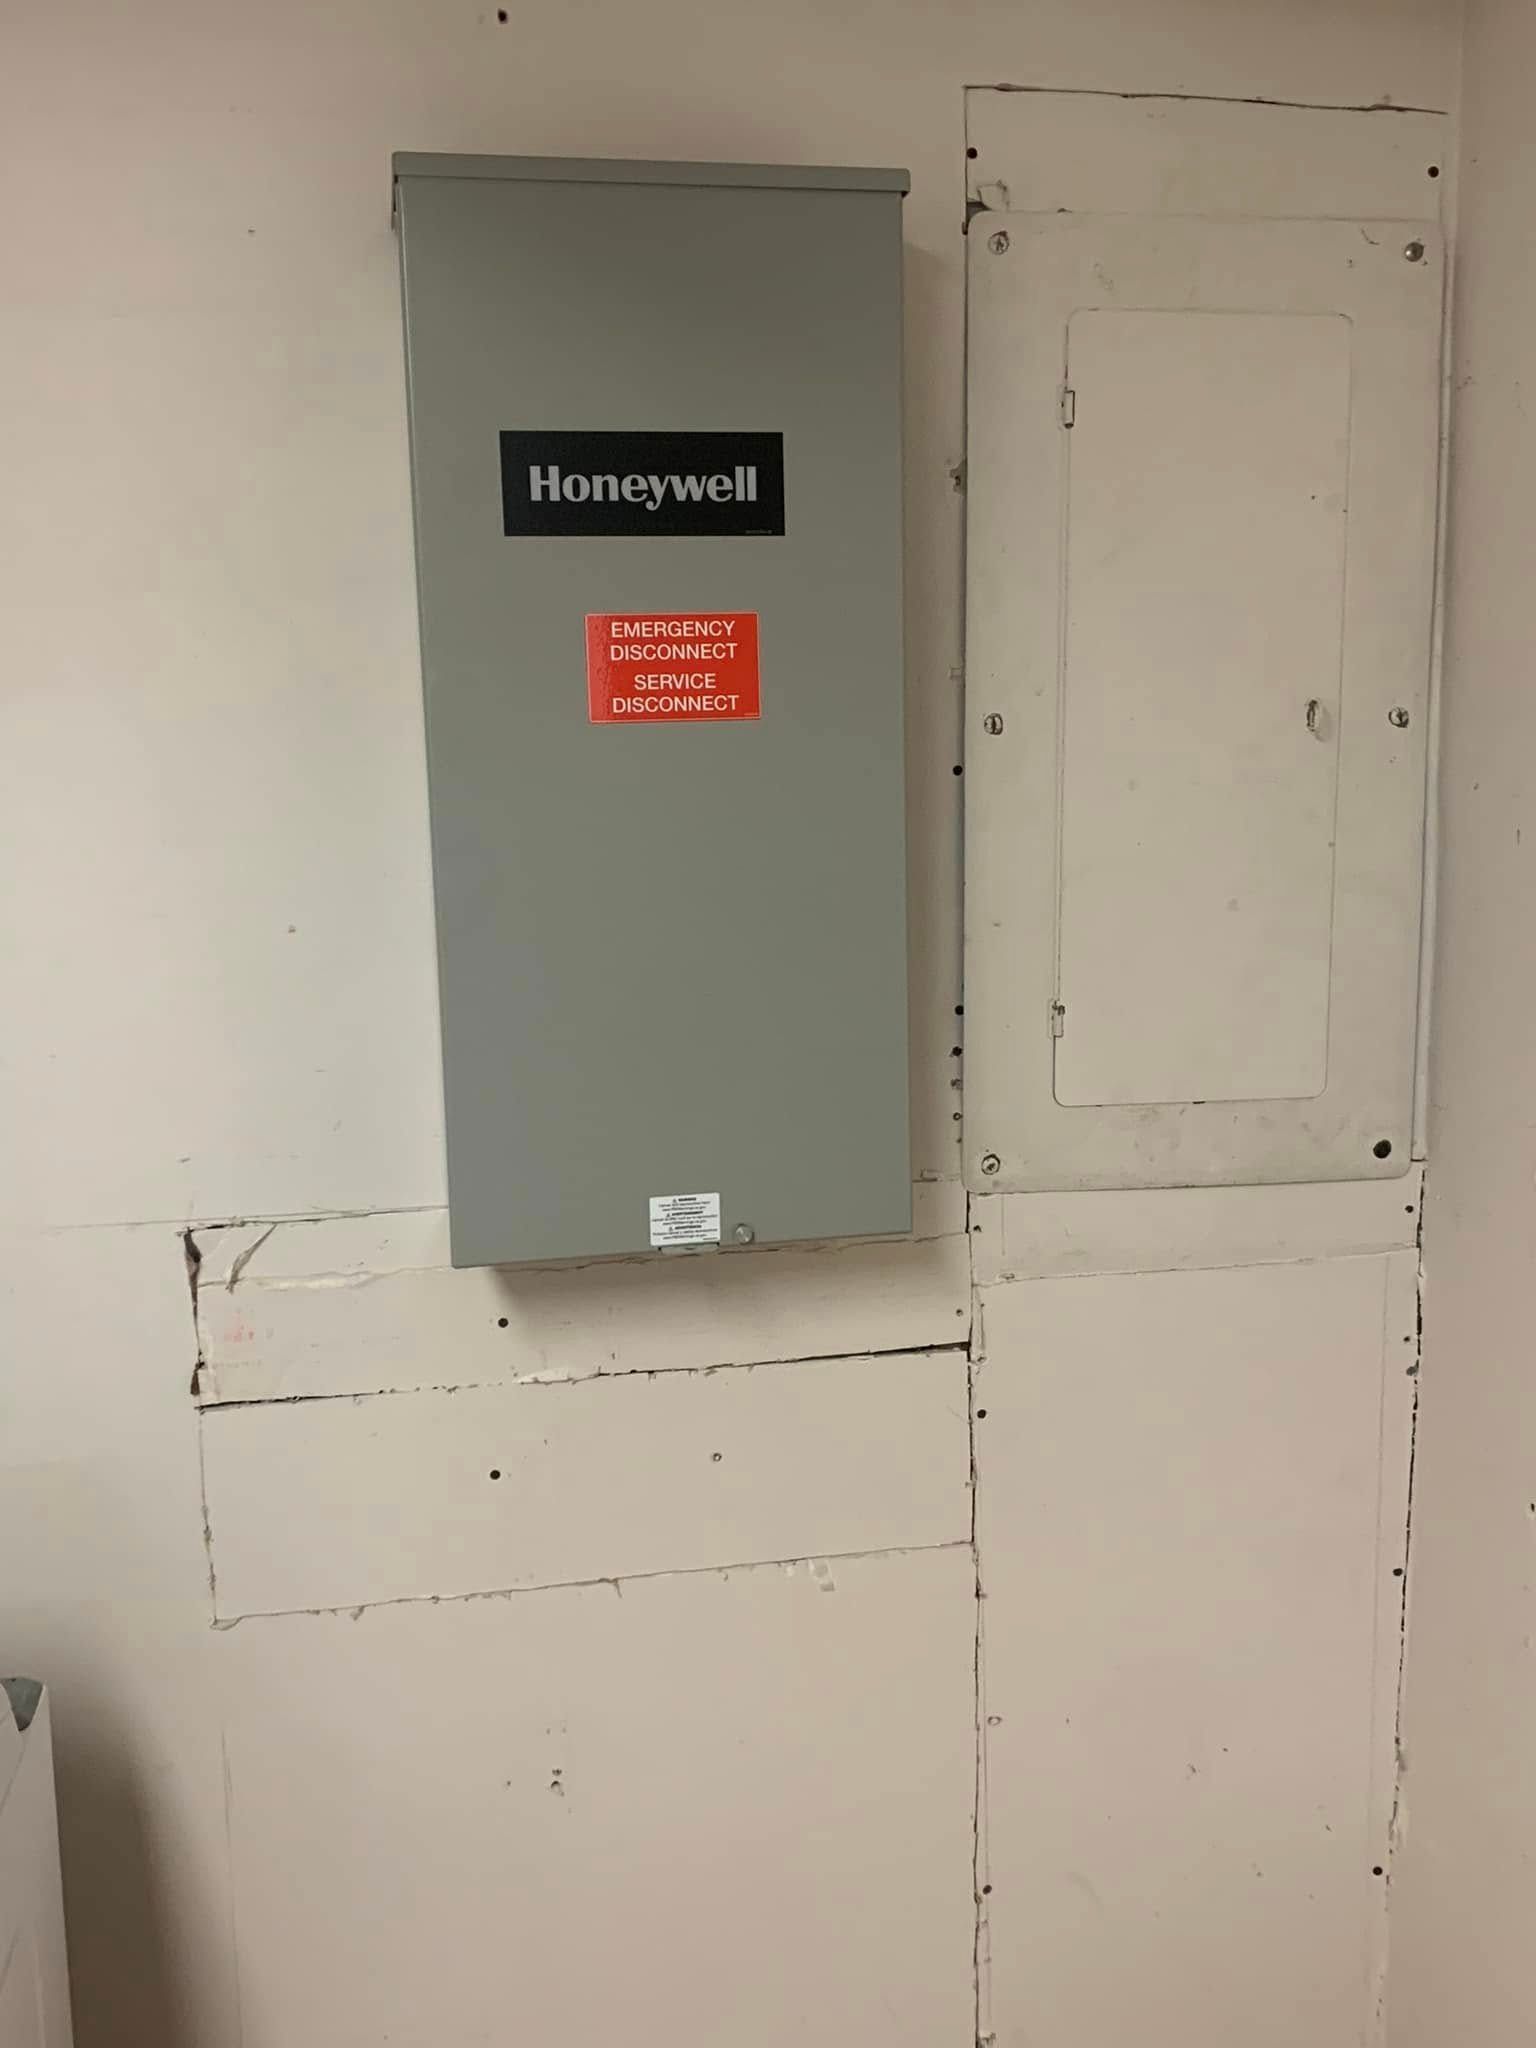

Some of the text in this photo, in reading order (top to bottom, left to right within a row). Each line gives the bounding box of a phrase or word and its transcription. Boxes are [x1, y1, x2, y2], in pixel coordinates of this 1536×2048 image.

[530, 466, 756, 510] Honeywell
[612, 621, 734, 637] EMERGENCY
[611, 643, 737, 660] DISCONNECT
[635, 674, 716, 690] SERVICE
[613, 695, 739, 713] DISCONNECT
